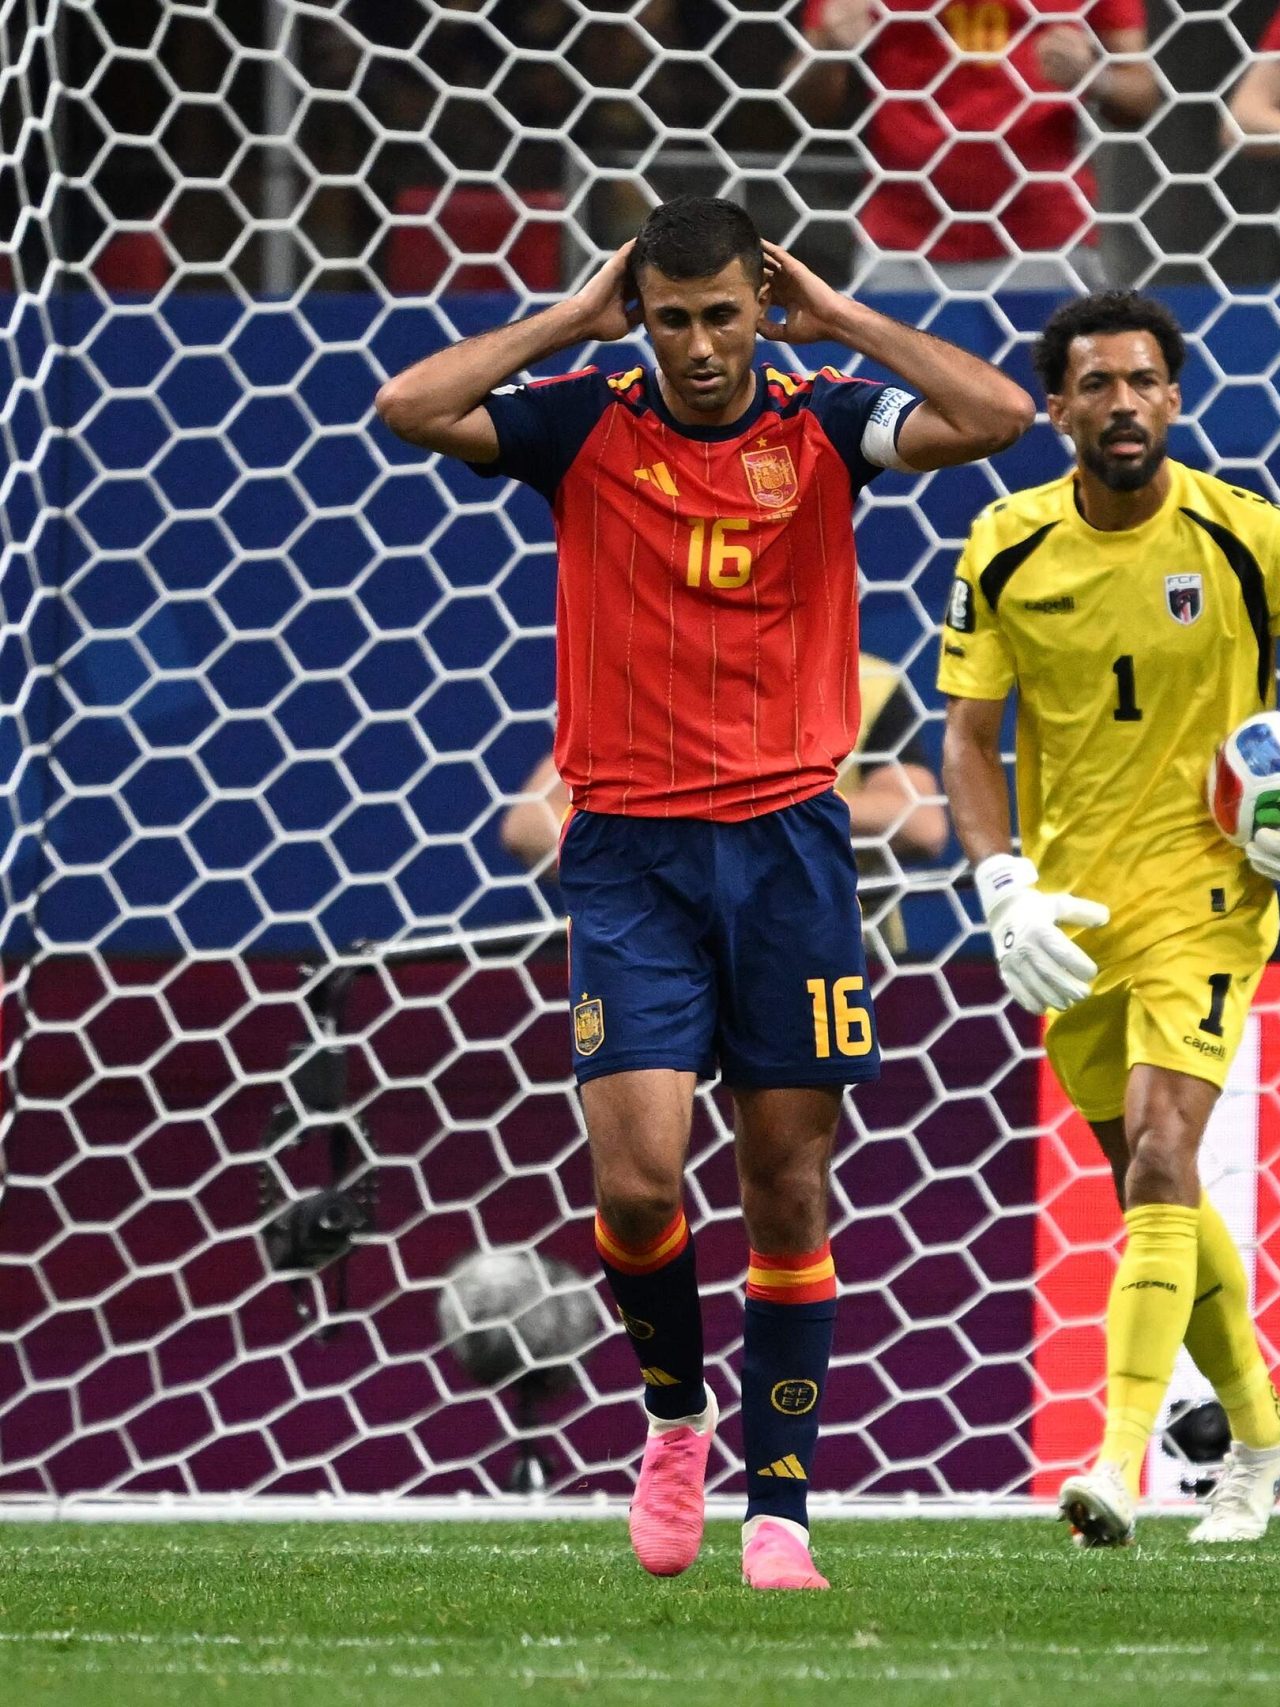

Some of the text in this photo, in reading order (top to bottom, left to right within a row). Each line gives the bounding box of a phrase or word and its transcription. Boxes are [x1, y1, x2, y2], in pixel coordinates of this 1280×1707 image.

[686, 516, 752, 589] 16
[1112, 654, 1143, 721] 1
[806, 975, 873, 1058] 16
[1198, 973, 1233, 1038] 1
